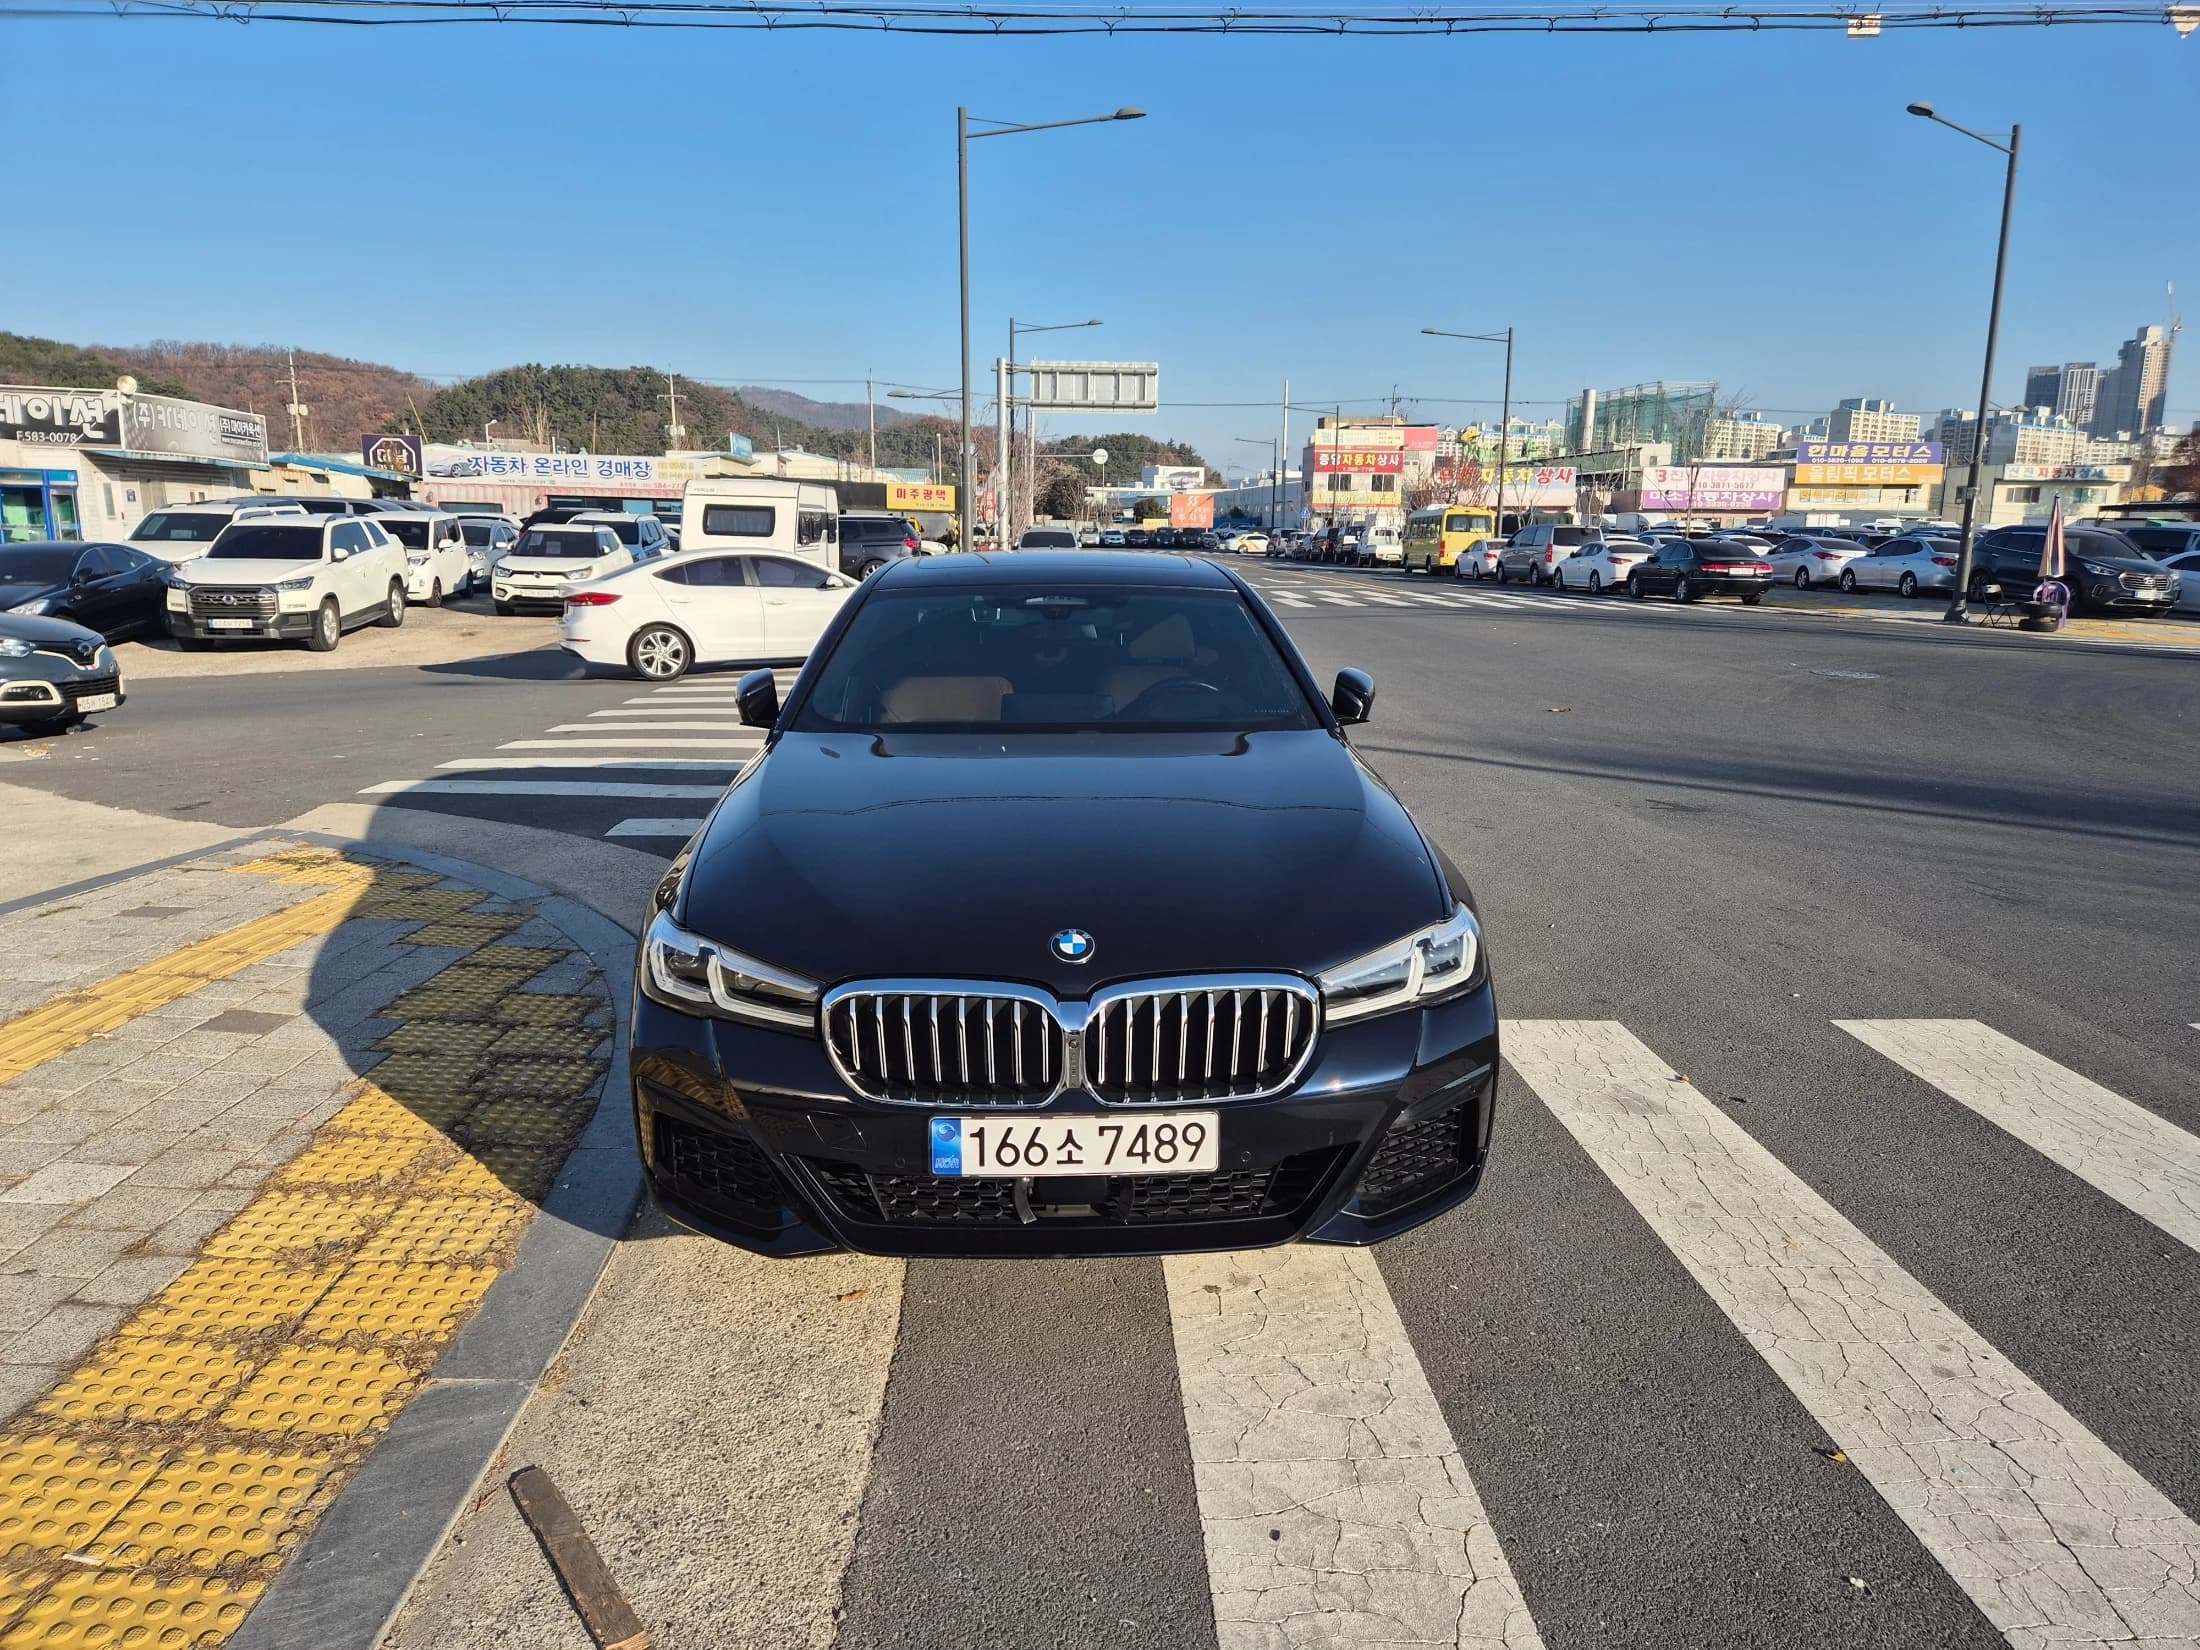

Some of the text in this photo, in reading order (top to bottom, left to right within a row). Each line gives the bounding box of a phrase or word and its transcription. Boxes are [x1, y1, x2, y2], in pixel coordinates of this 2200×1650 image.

[471, 456, 527, 474] 자동차
[533, 457, 589, 476] 온라인
[596, 459, 653, 479] 경매장
[896, 487, 946, 501] 미주광택
[969, 1122, 1207, 1167] 166소 7489
